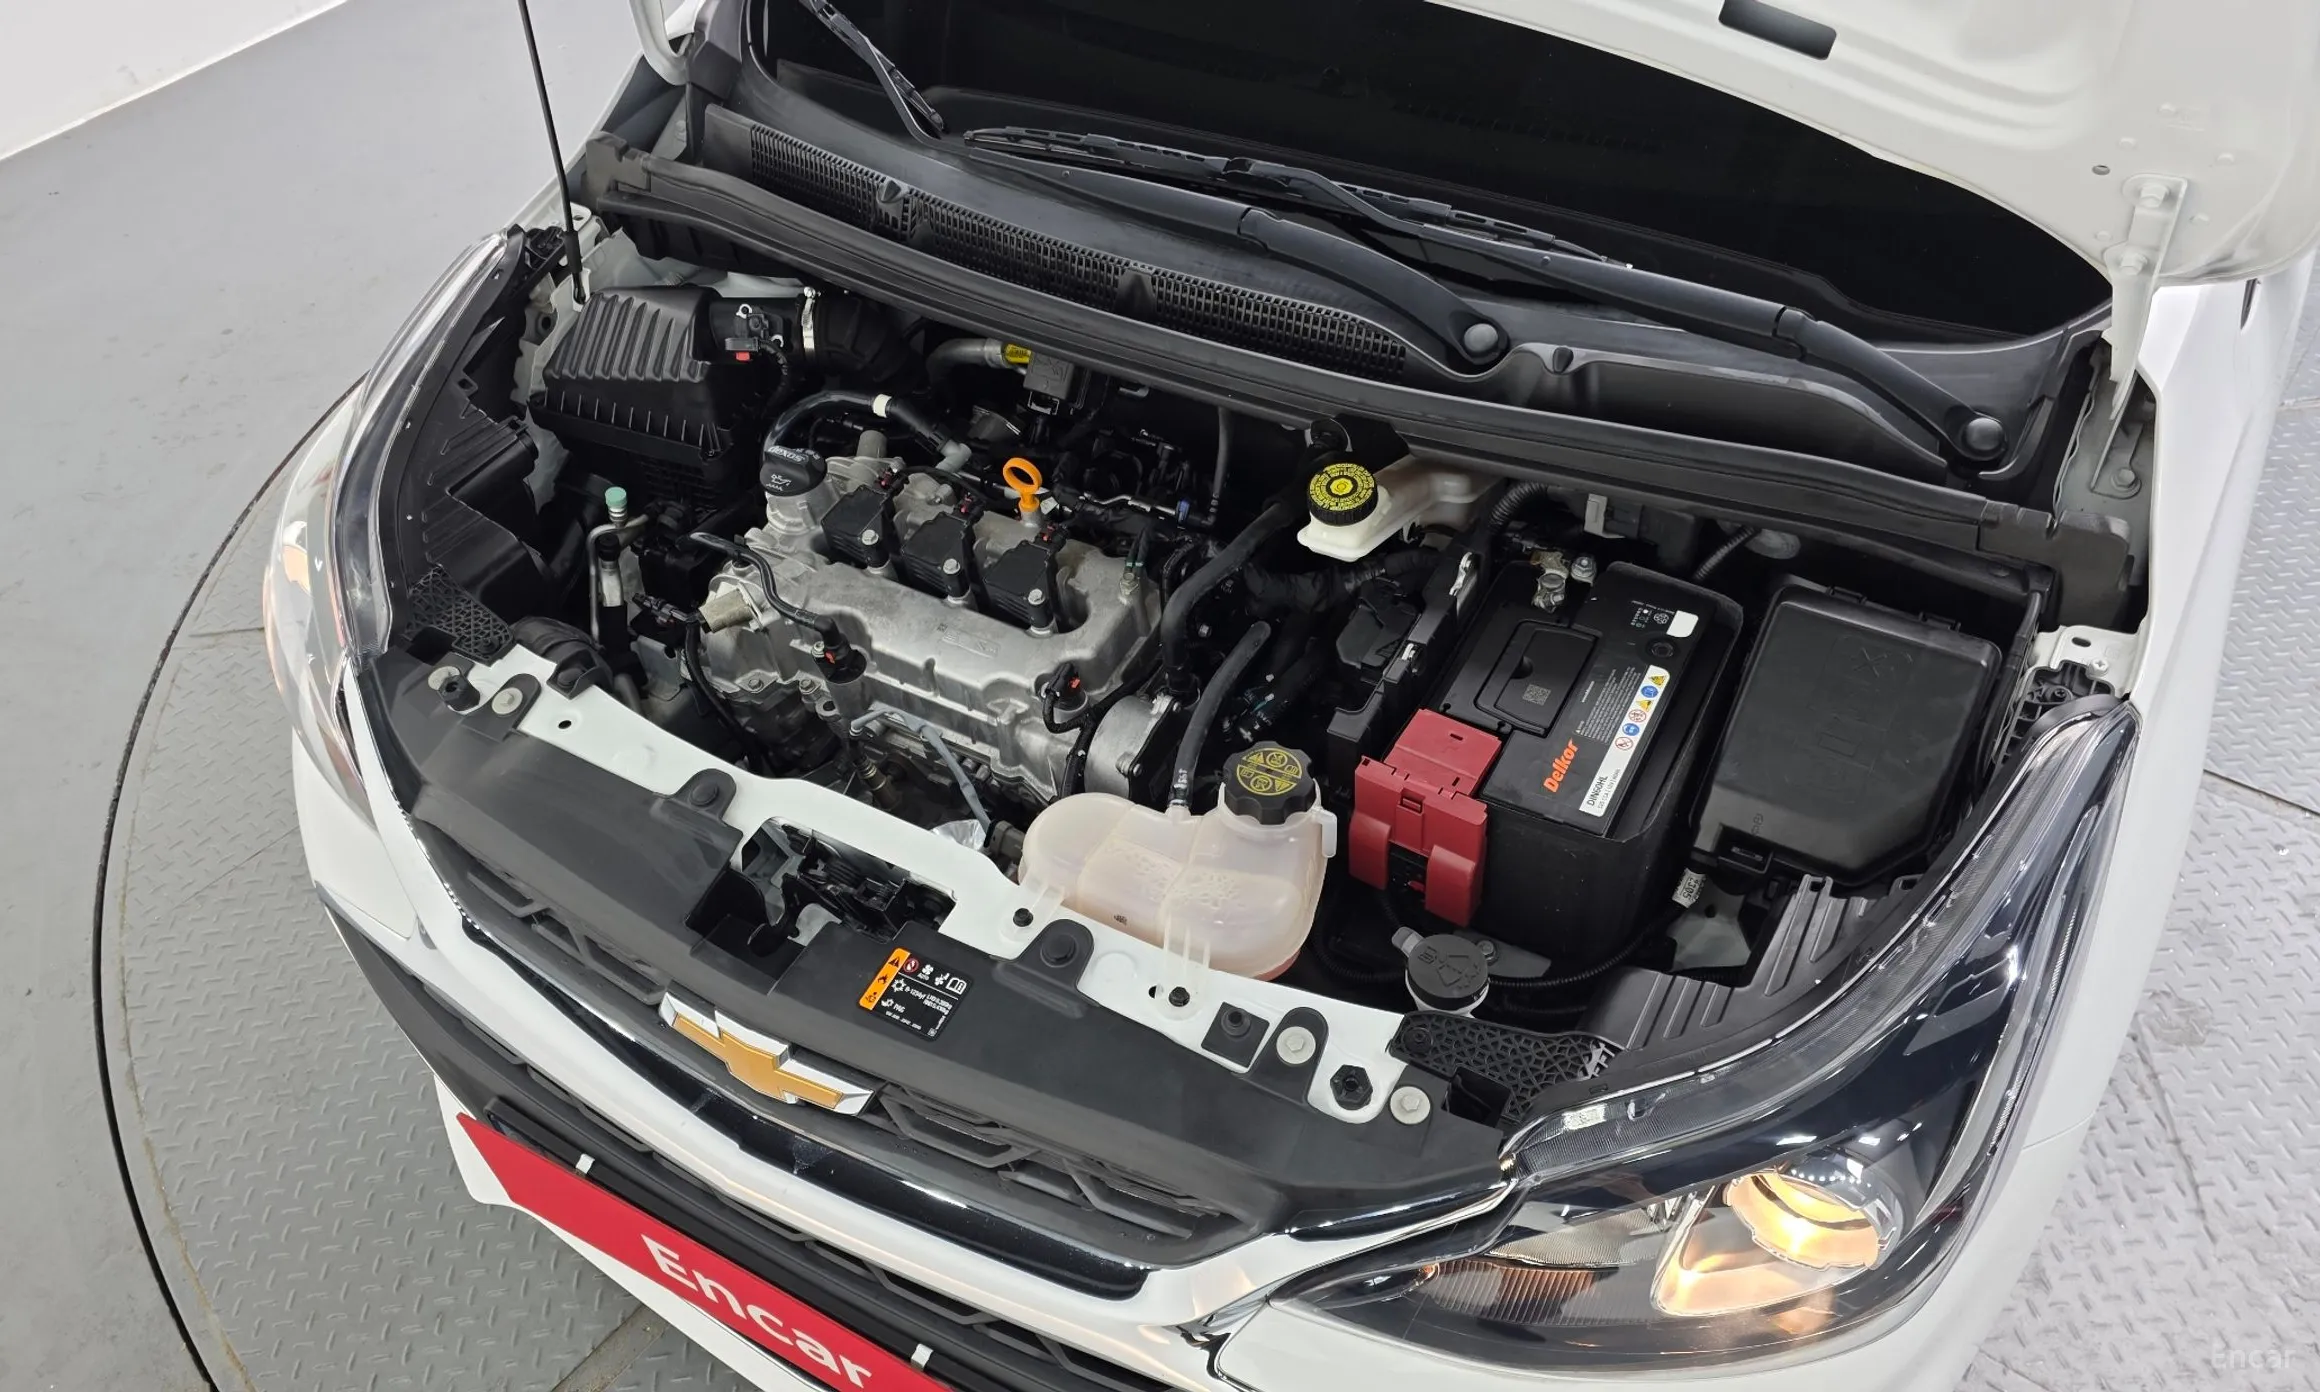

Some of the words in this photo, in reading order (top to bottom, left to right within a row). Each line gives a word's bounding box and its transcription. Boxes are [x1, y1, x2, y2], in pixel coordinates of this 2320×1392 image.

[768, 445, 805, 462] dexos
[1543, 738, 1579, 793] Delkor
[641, 1233, 873, 1388] Encar
